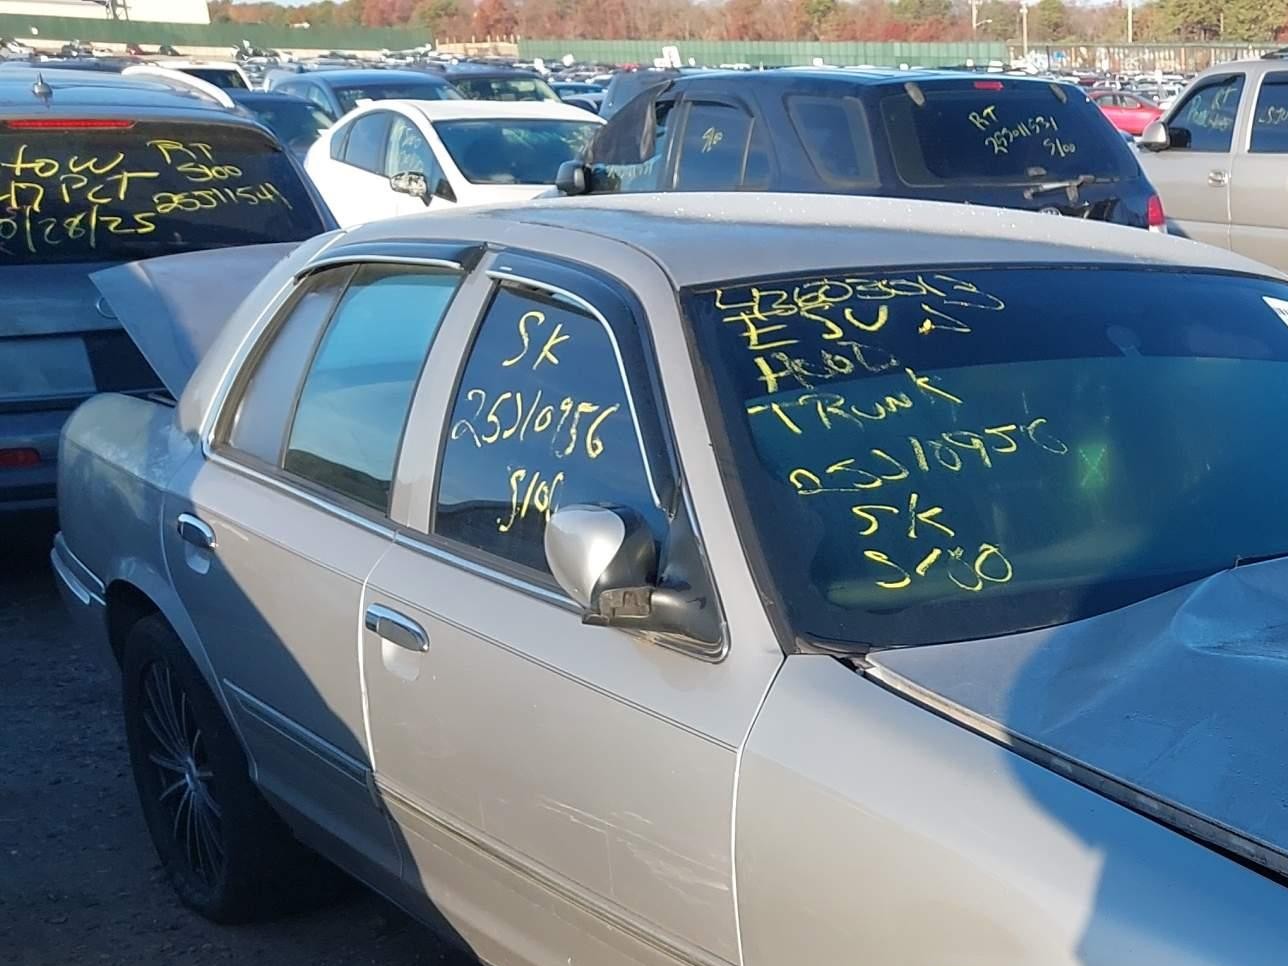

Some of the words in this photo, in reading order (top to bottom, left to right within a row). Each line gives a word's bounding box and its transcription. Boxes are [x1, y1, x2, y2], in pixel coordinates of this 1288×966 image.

[968, 105, 998, 131] RT
[59, 171, 160, 204] PCT
[501, 311, 570, 370] SK
[746, 367, 964, 434] TRUNK
